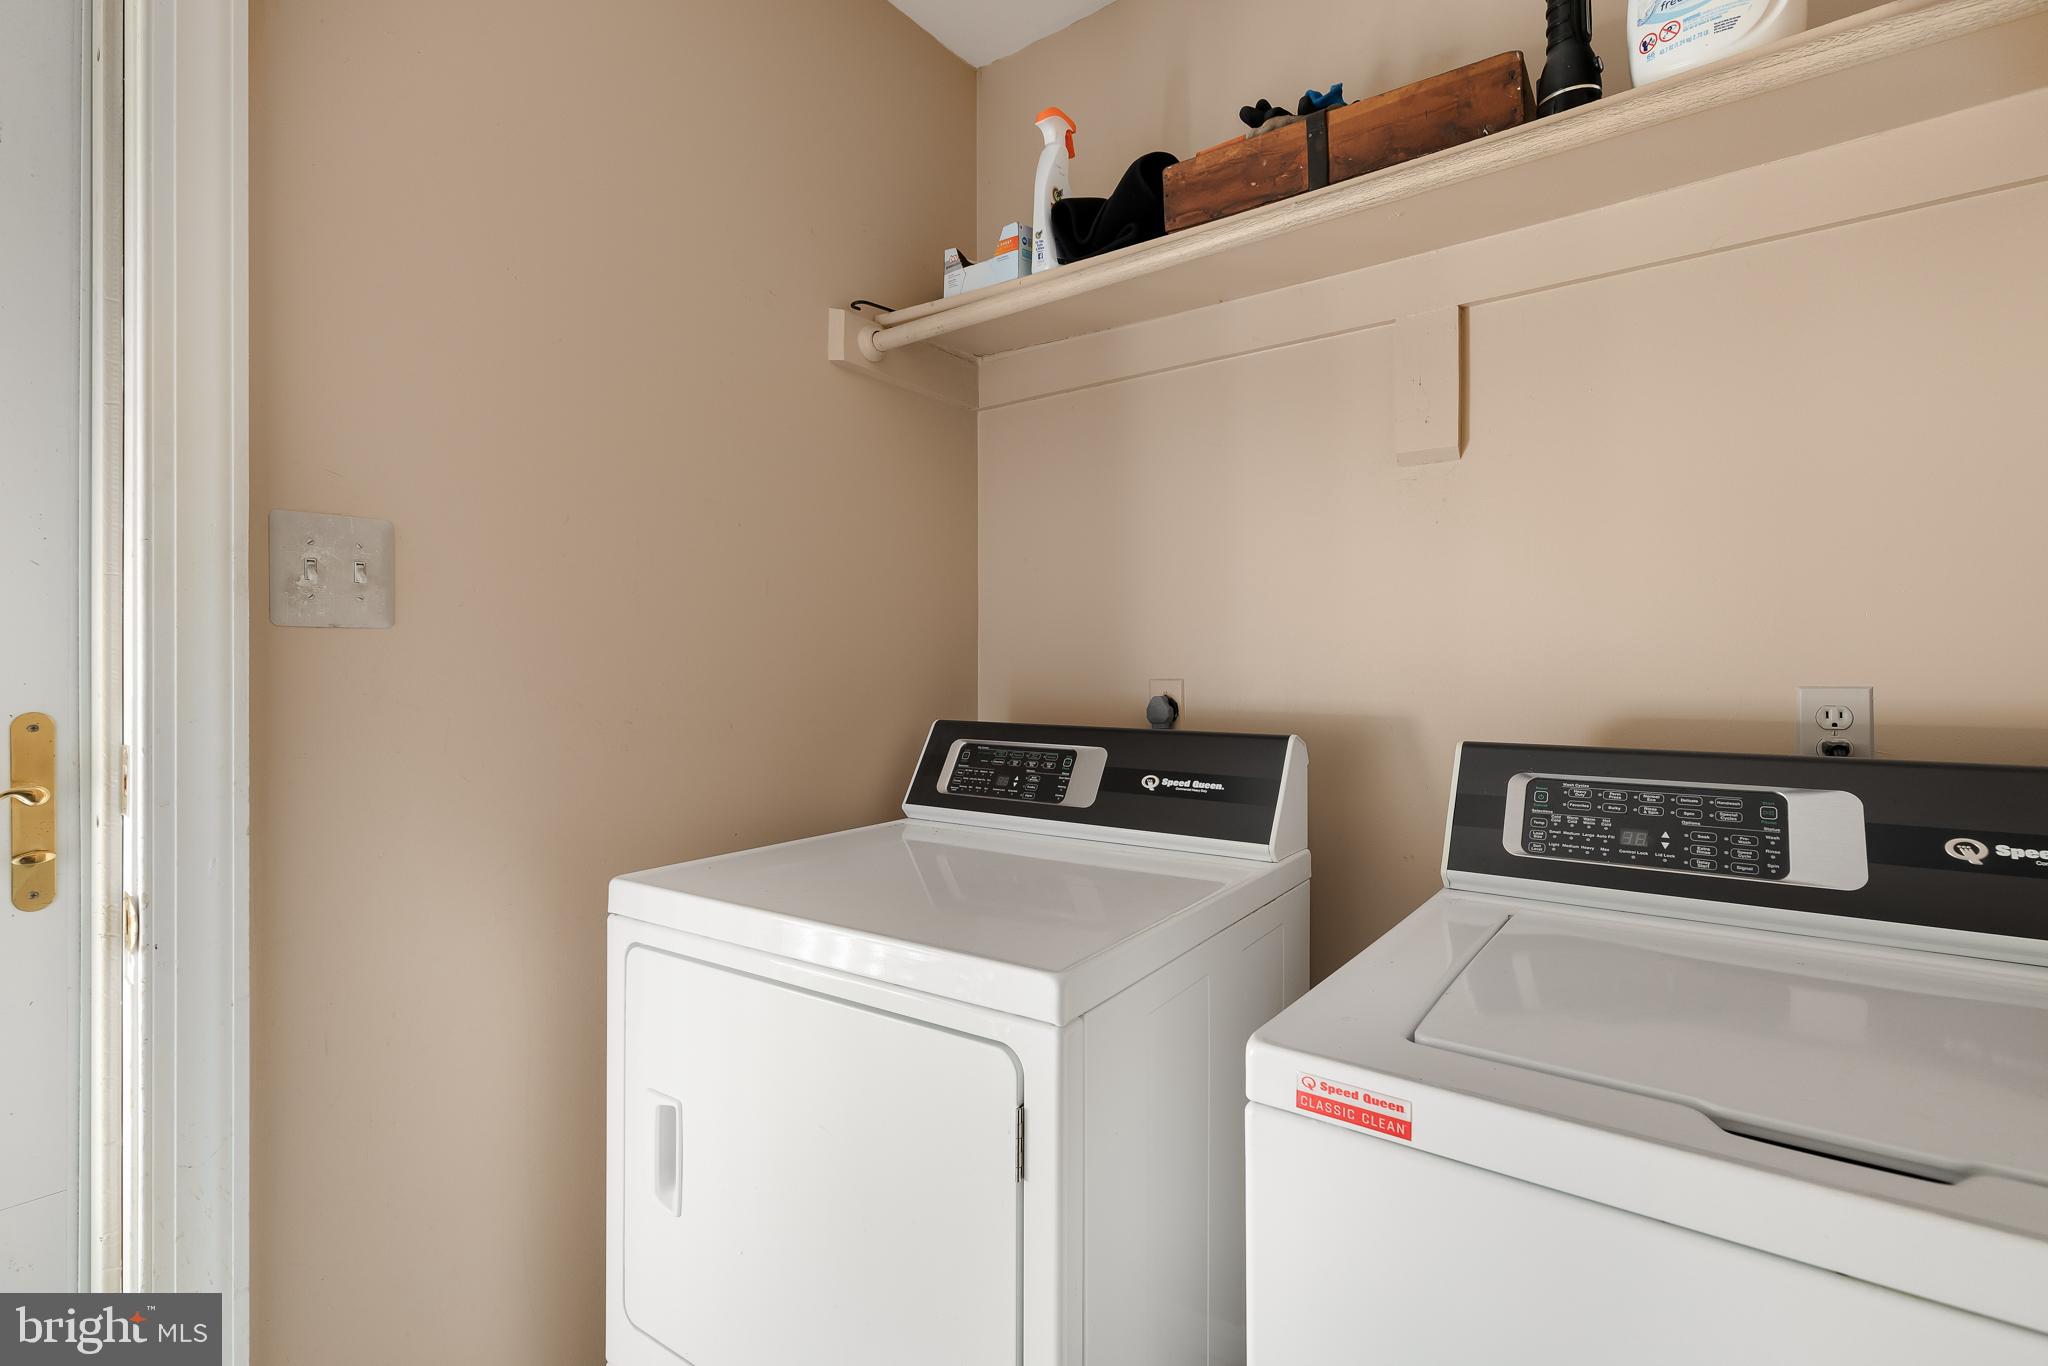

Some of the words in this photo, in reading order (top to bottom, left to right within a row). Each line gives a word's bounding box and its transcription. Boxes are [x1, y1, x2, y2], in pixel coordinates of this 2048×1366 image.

[1661, 0, 1681, 11] fre
[1161, 778, 1191, 787] Speed
[1320, 1081, 1359, 1100] Speed
[1363, 1093, 1405, 1113] Queen
[1300, 1095, 1355, 1120] CLASSIC
[1362, 1113, 1405, 1135] CLEAN
